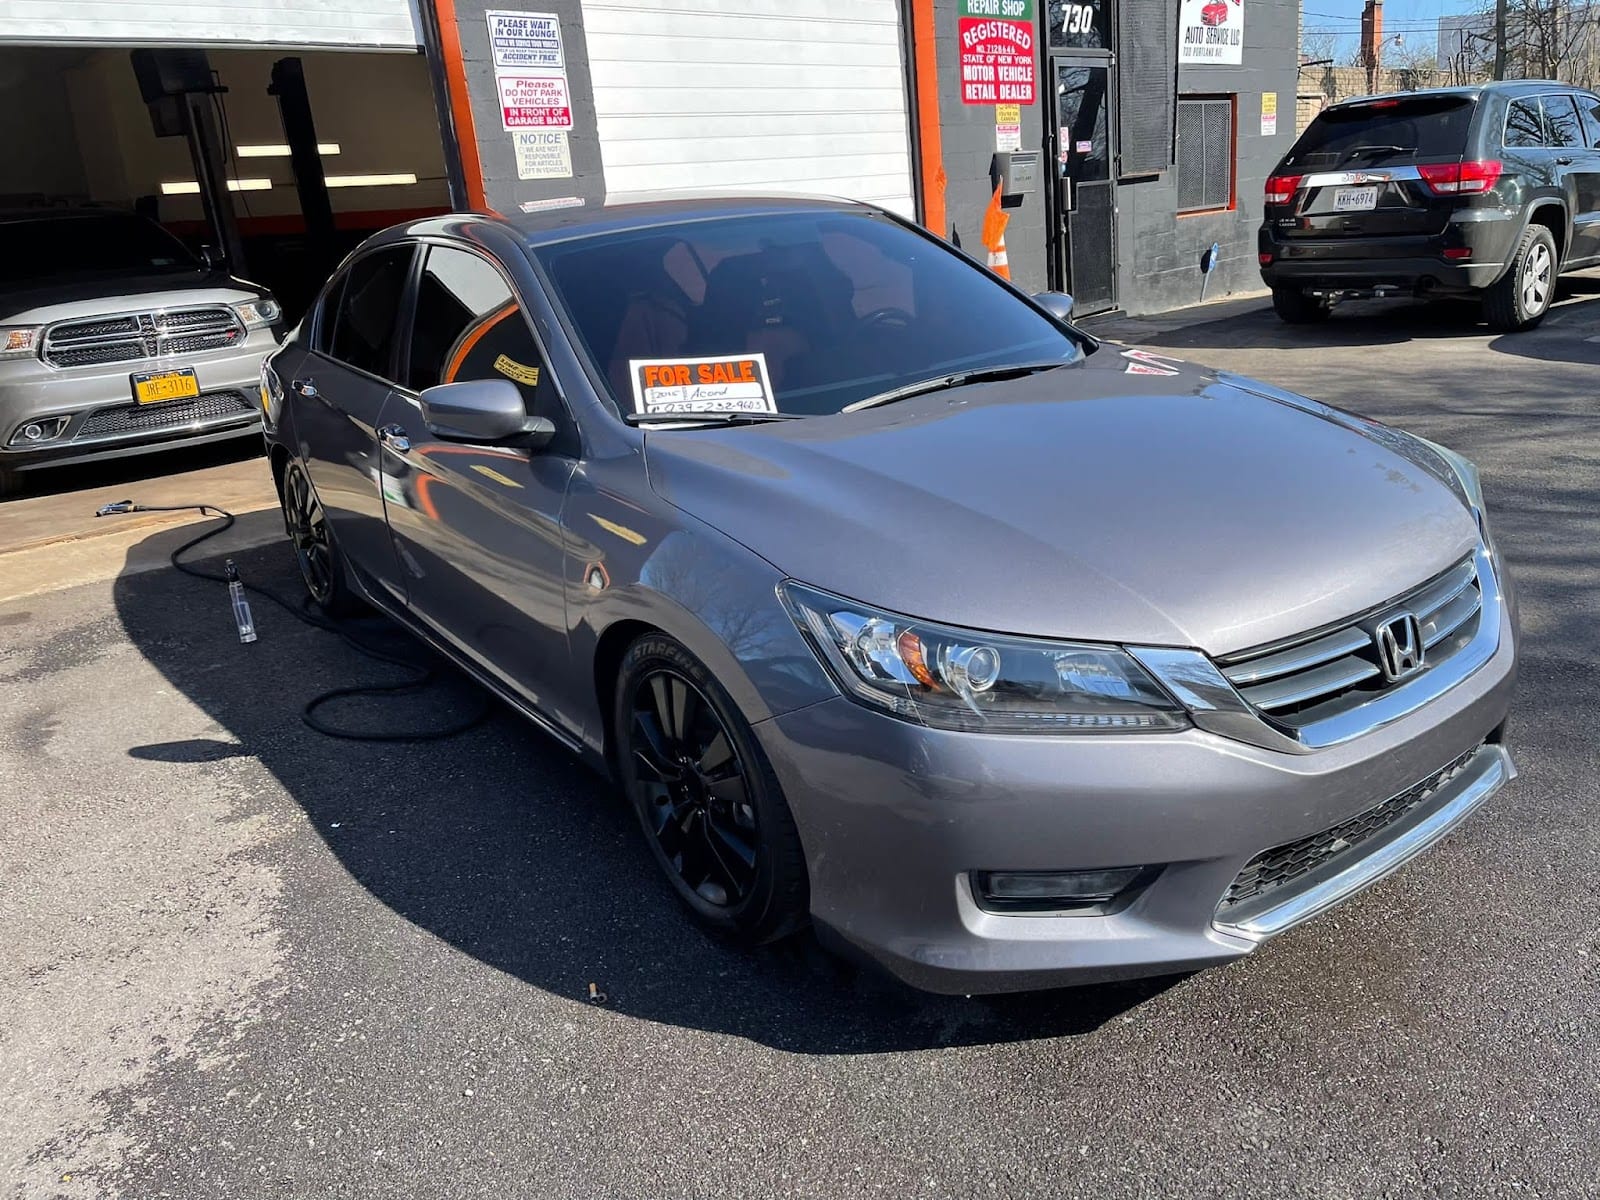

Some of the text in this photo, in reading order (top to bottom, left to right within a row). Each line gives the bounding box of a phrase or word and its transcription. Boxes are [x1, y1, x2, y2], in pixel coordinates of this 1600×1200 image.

[967, 0, 1025, 16] REPAIR SHOP
[497, 19, 551, 29] PLEASE WAIT
[1061, 4, 1093, 34] 730
[495, 28, 556, 38] IN OUR LOUNGE
[962, 21, 1031, 50] REGISTERED
[1184, 26, 1241, 46] AUTO SERVICE LLC
[963, 53, 1032, 65] STATE OF NEW YORK
[963, 65, 1033, 82] MOTOR VEHICLE
[516, 80, 555, 88] Please
[505, 88, 563, 97] DO NOT PARK
[965, 83, 1033, 100] RETAIL DEALER
[512, 97, 560, 105] VEHICLES
[509, 108, 519, 116] IN
[520, 108, 550, 116] FRONT
[507, 117, 569, 126] GARAGE BAYS
[520, 133, 561, 145] NOTICE
[524, 152, 561, 160] RESPONSIBLE
[644, 361, 756, 388] FOR SALE
